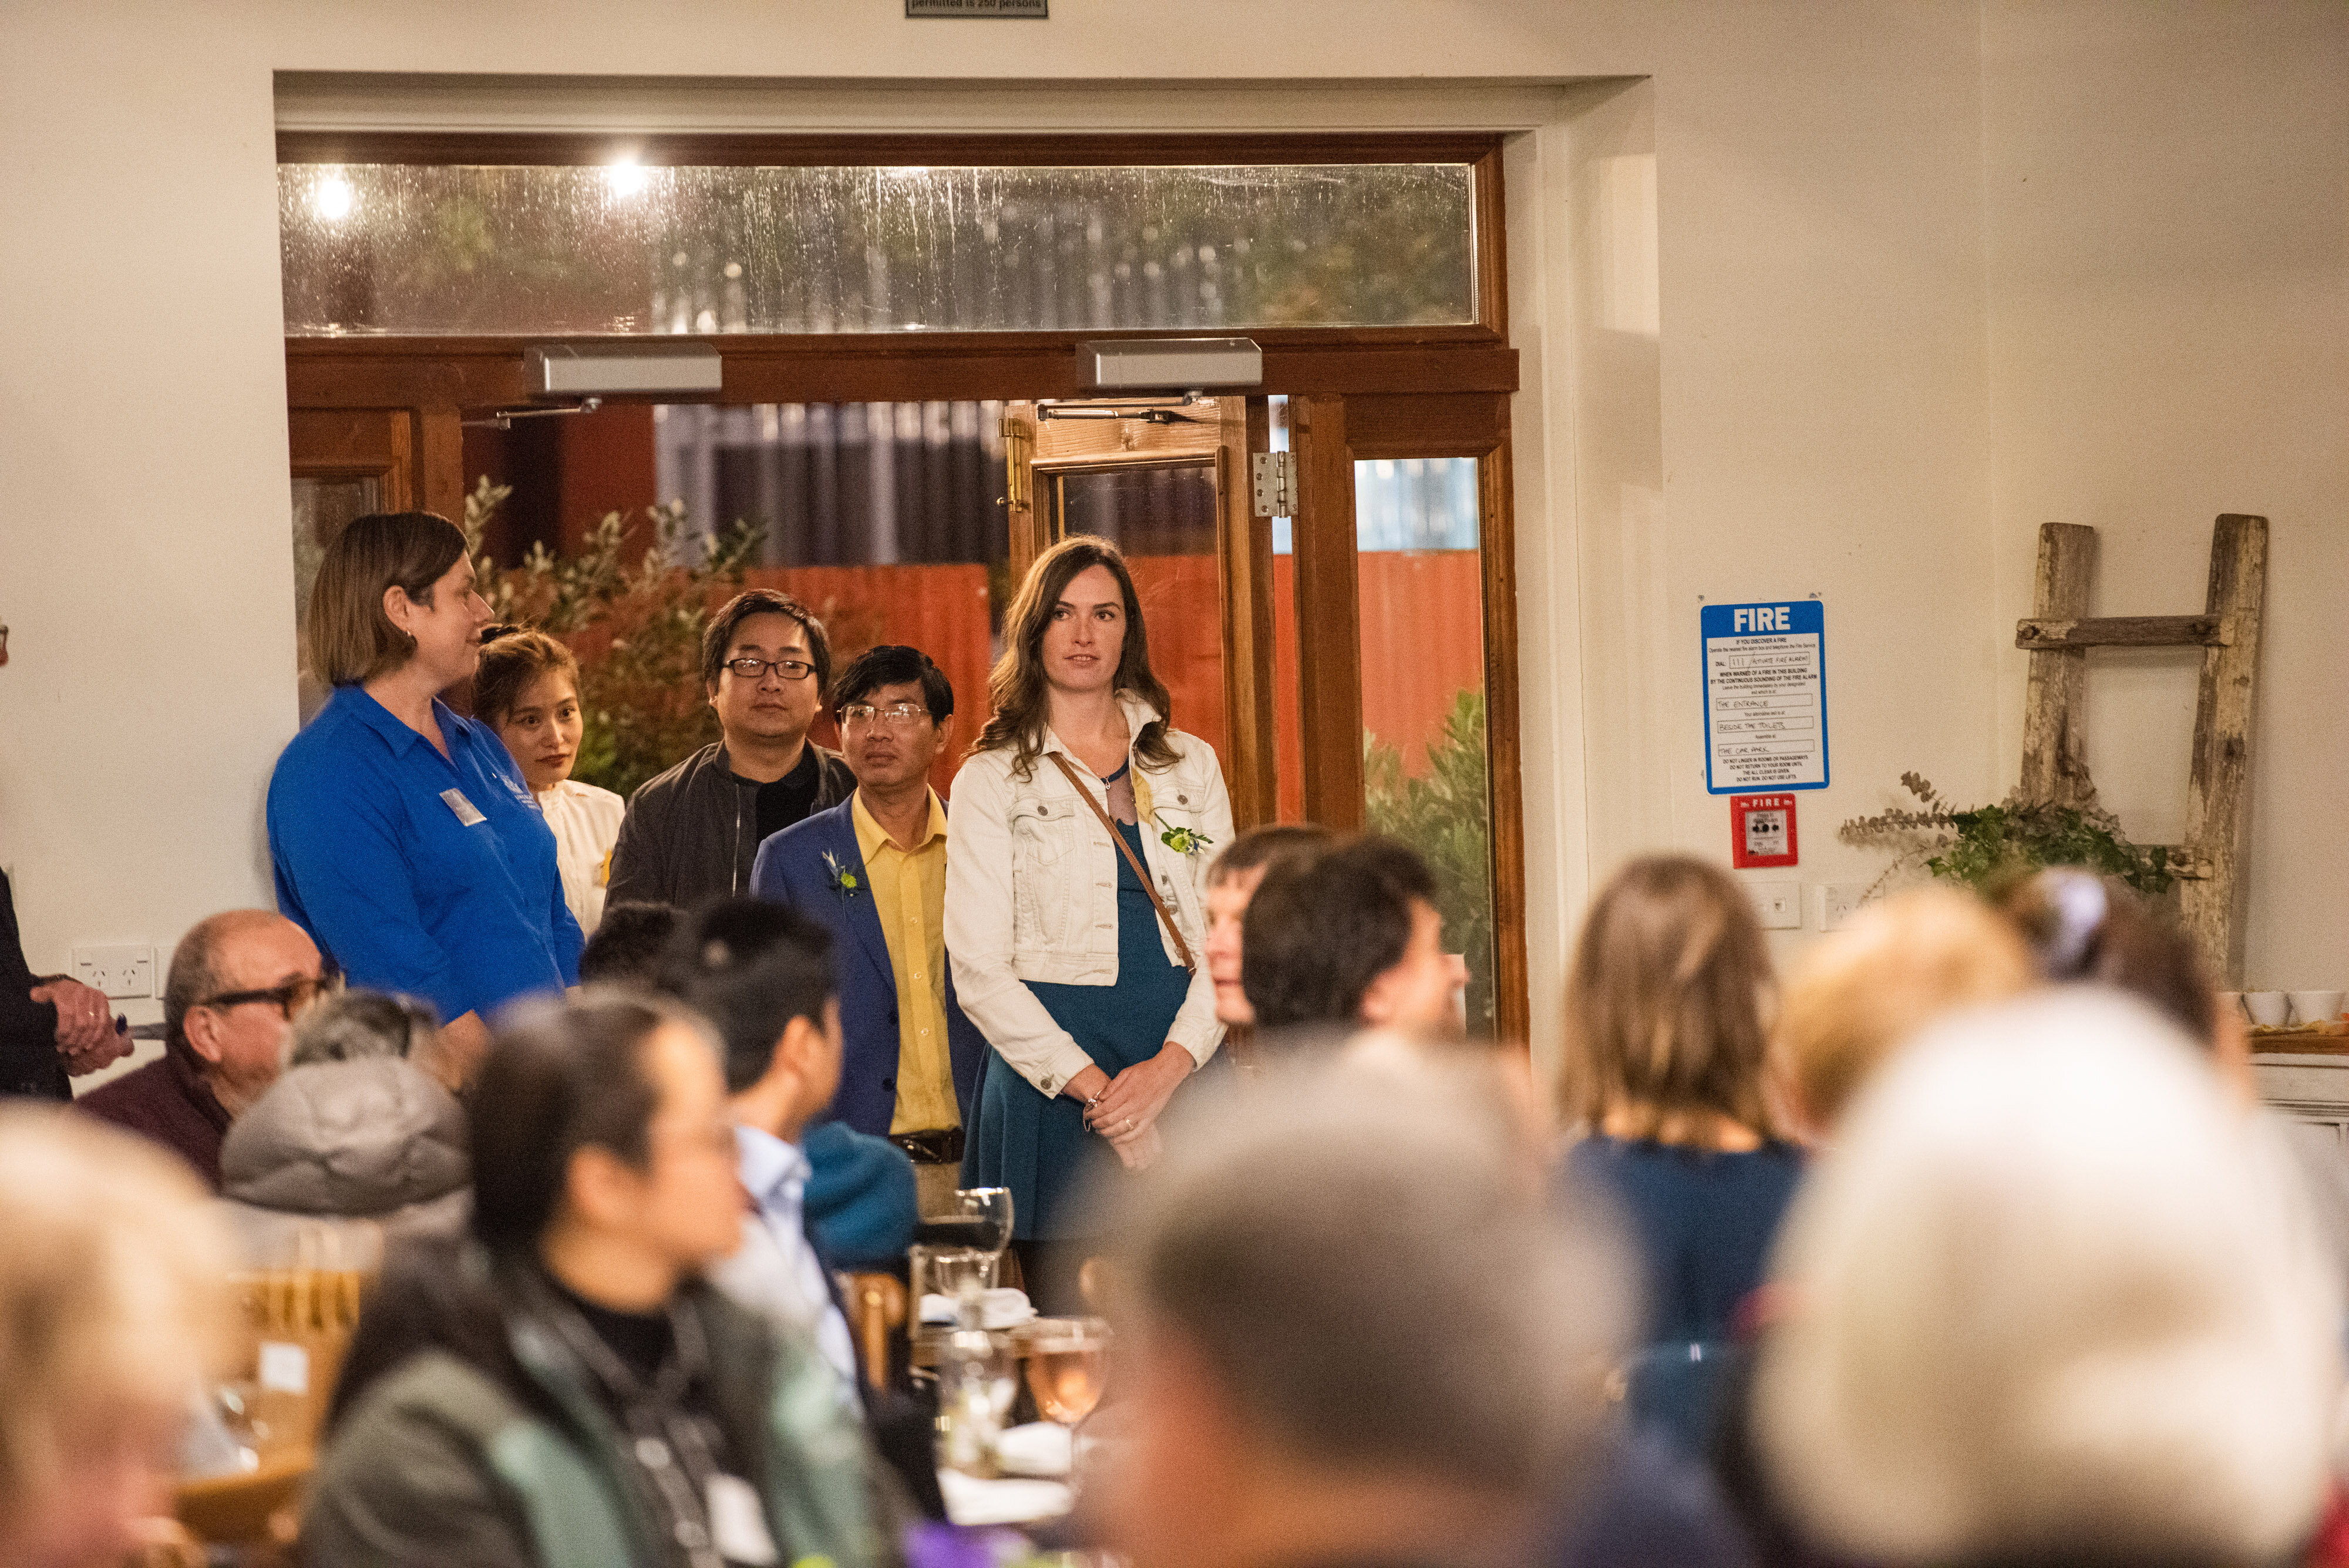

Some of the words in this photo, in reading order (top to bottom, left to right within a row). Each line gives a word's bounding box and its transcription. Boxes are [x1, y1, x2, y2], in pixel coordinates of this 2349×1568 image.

[999, 0, 1041, 9] persons
[1734, 607, 1791, 632] FIRE
[1753, 798, 1780, 807] FIRE
